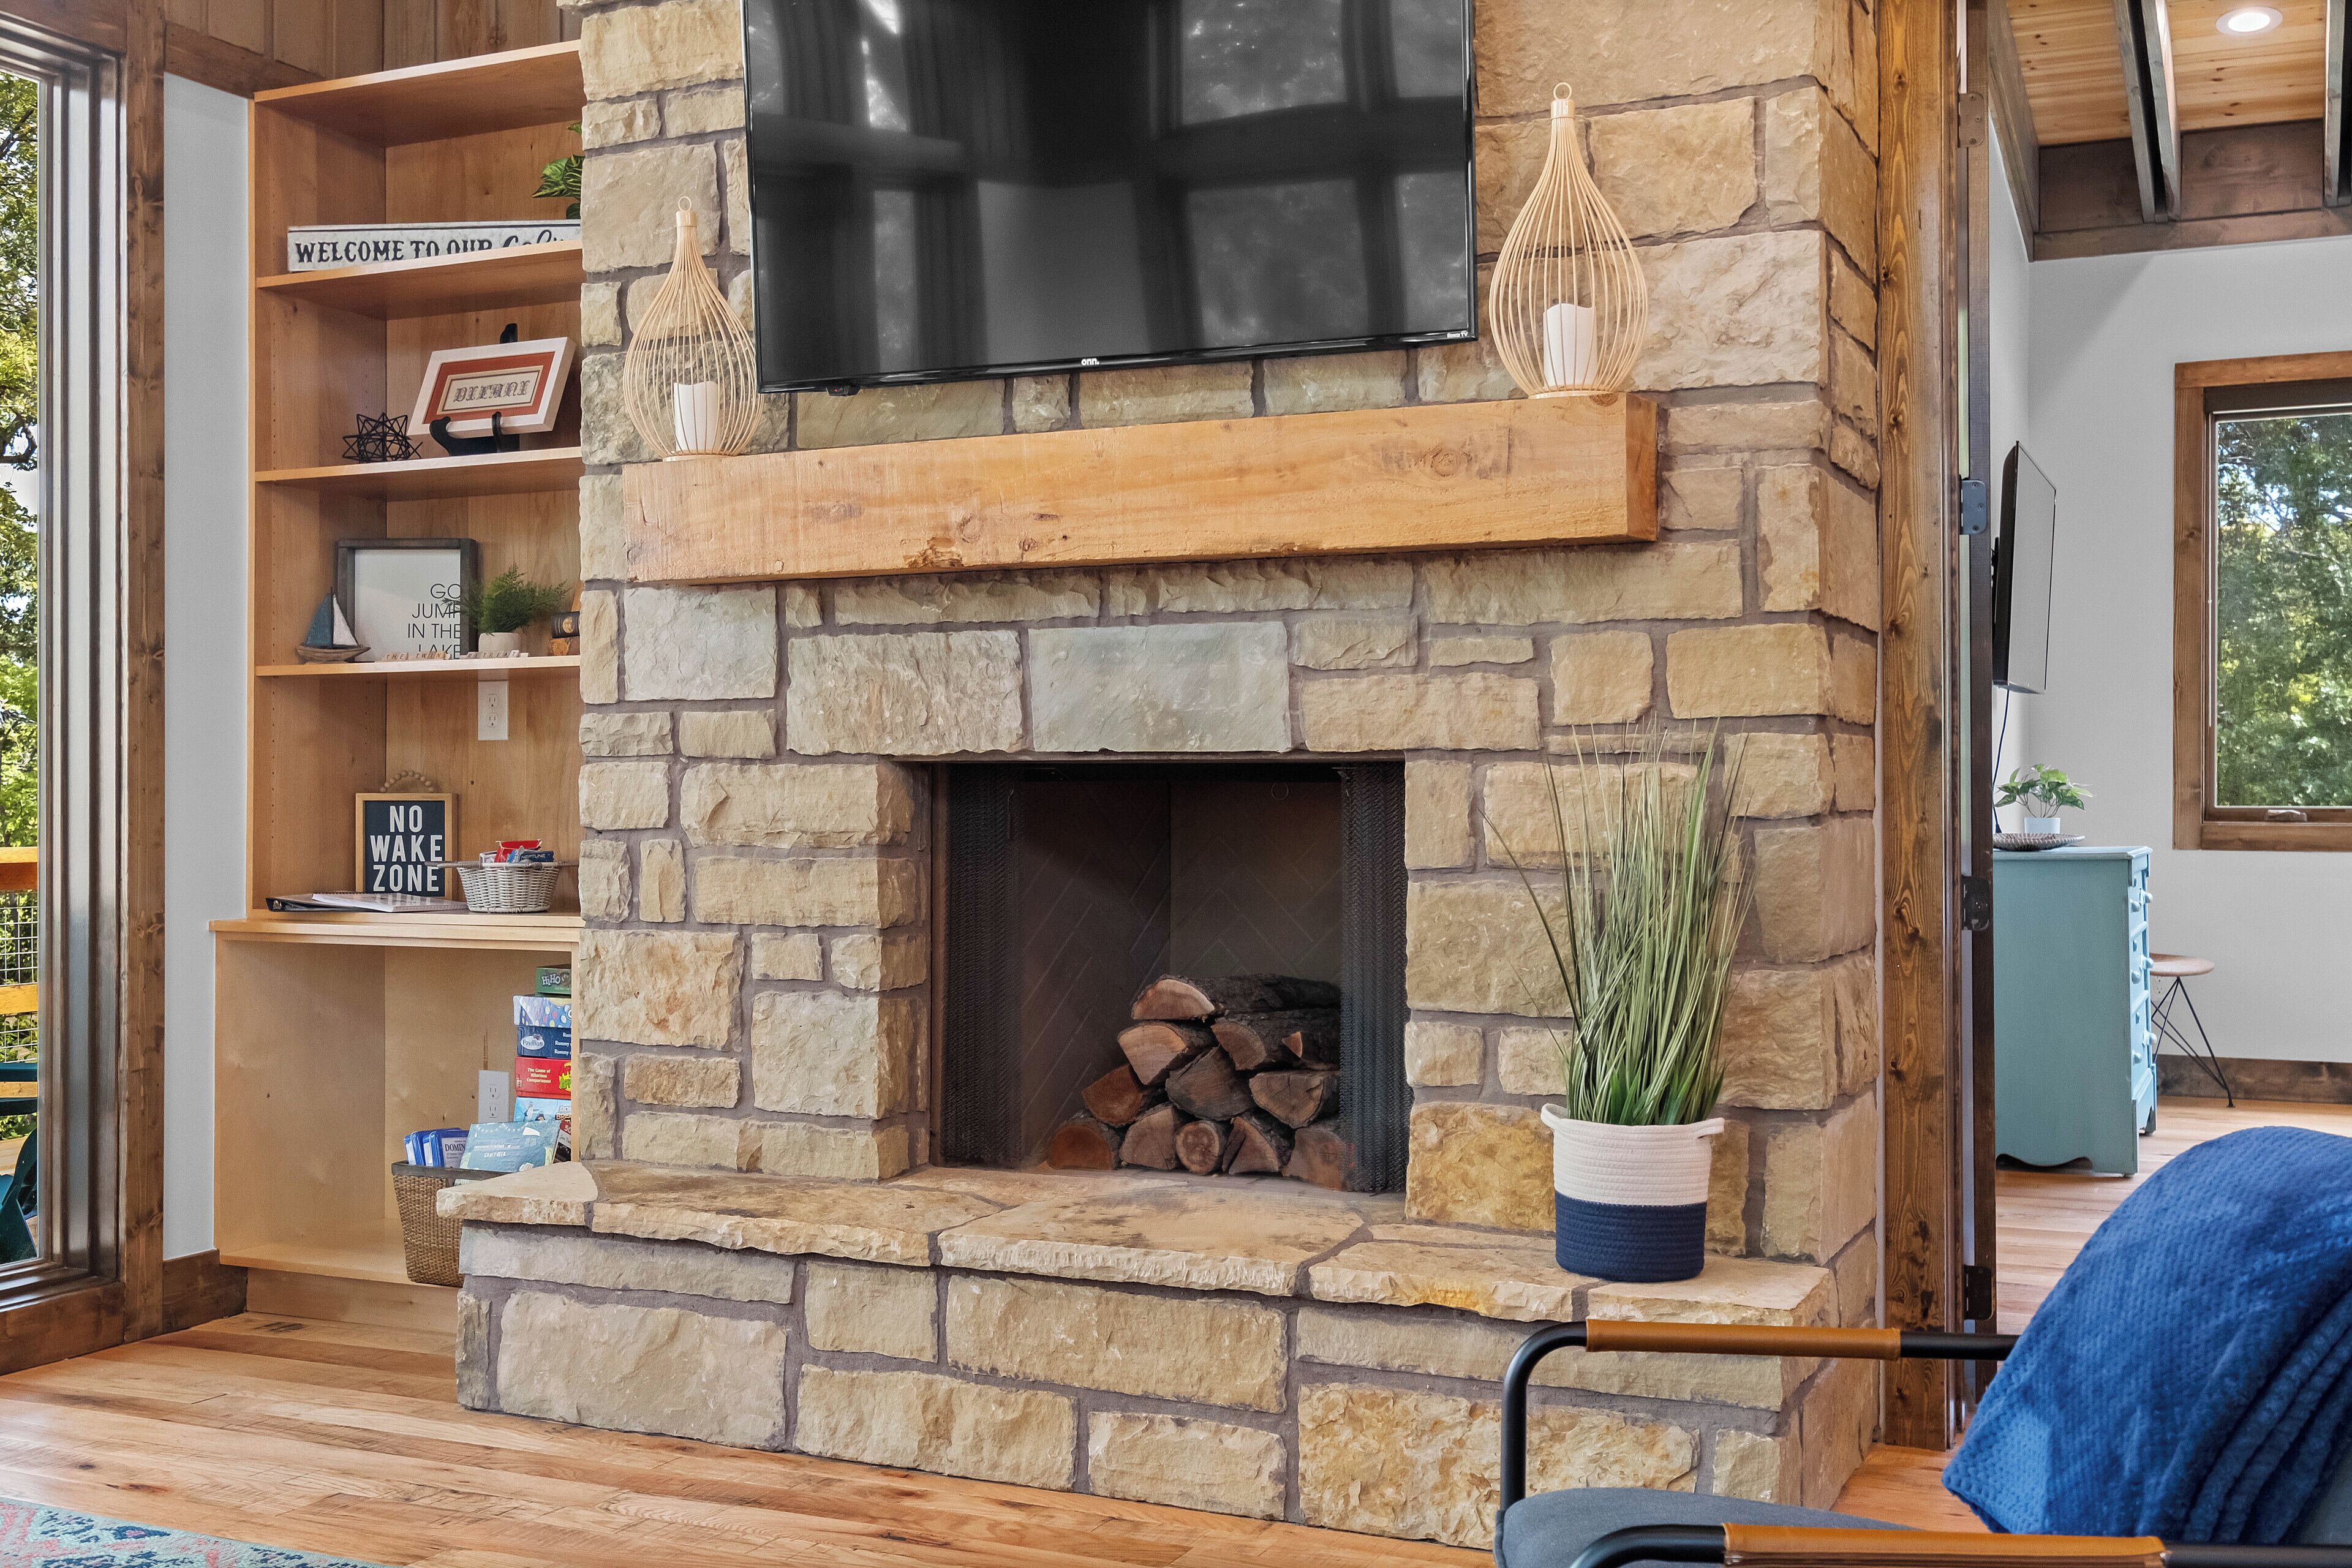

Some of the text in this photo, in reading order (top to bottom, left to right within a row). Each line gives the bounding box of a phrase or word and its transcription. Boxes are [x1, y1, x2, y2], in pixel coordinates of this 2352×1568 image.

[295, 241, 404, 262] WELCOME
[410, 241, 440, 258] TO
[431, 584, 460, 598] GO
[408, 624, 460, 638] IN THE
[390, 805, 423, 833] NO
[370, 835, 443, 862] WAKE
[373, 864, 439, 892] ZONE
